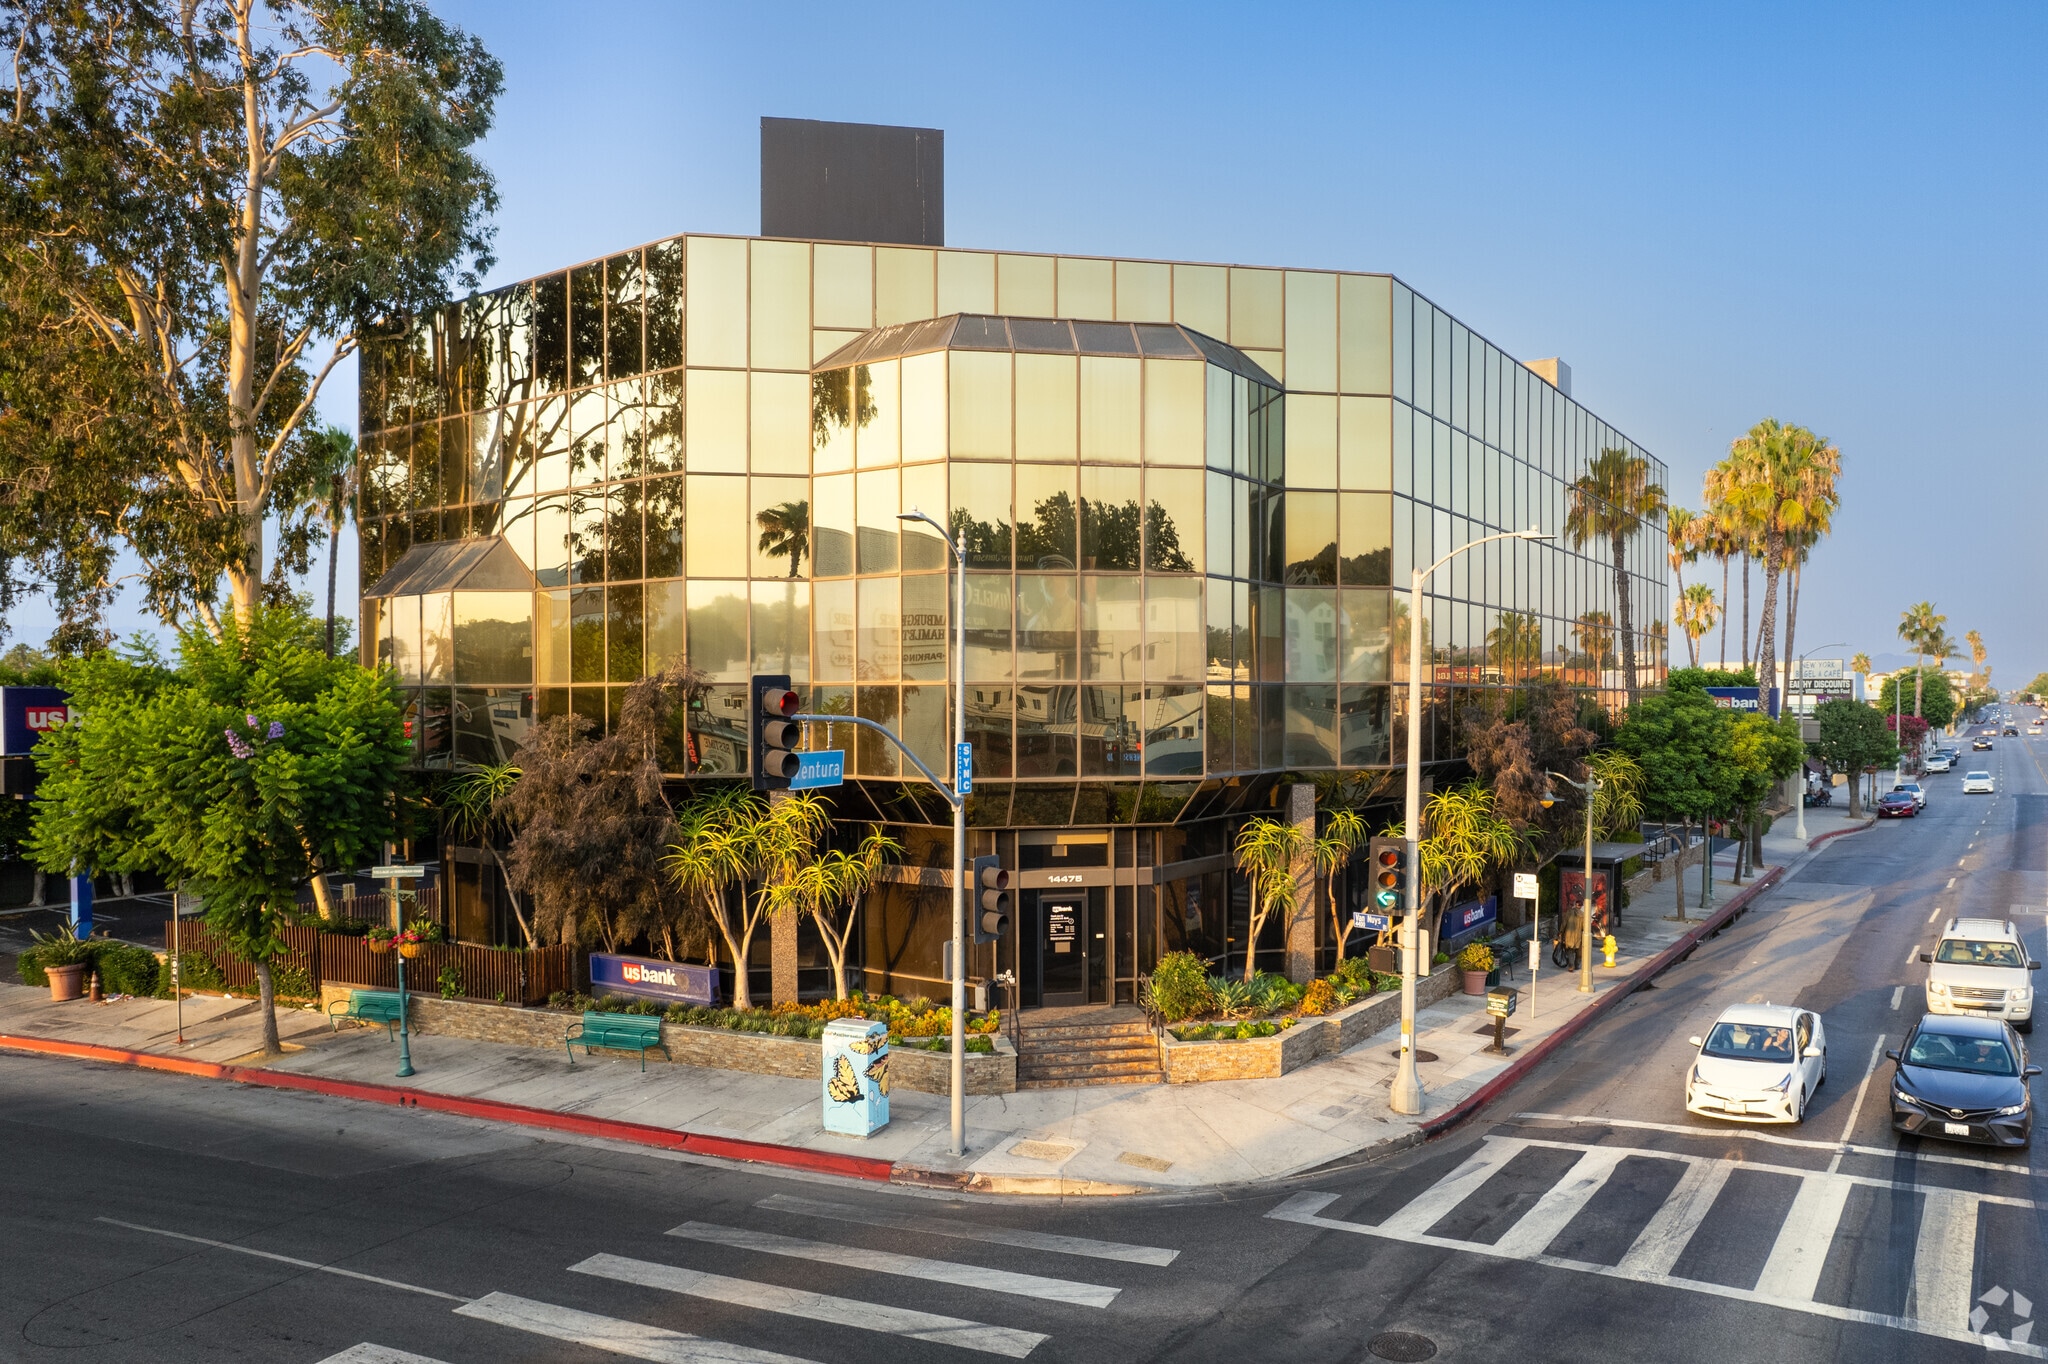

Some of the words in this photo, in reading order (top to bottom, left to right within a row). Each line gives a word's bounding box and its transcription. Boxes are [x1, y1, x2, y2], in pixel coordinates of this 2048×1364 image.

[1813, 680, 1851, 688] DISCOUNTS
[1715, 697, 1759, 708] usban
[795, 761, 840, 780] entura
[963, 745, 971, 790] SYNC
[1048, 875, 1083, 883] 14475
[1367, 915, 1382, 925] Nuys
